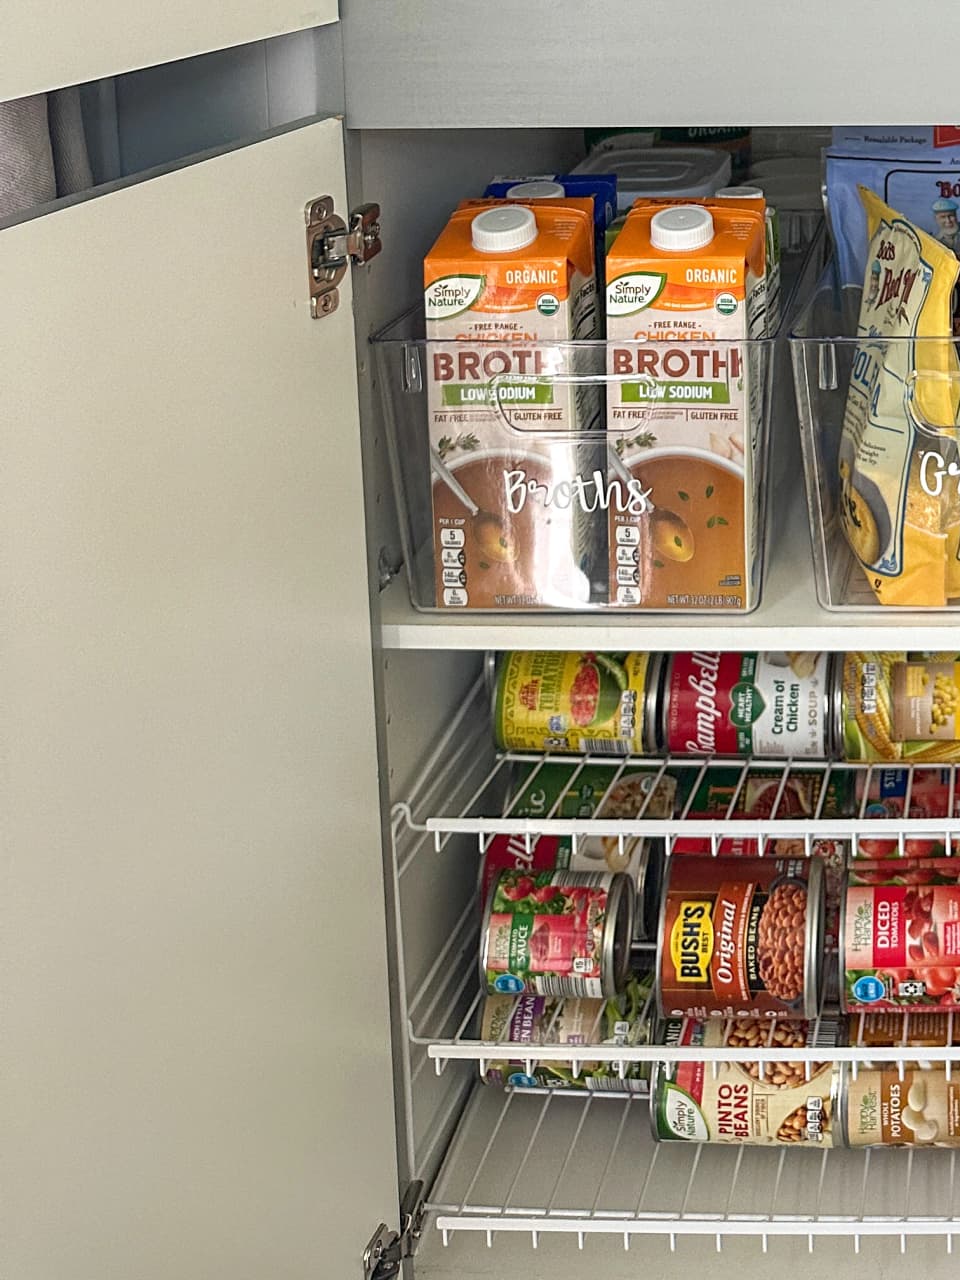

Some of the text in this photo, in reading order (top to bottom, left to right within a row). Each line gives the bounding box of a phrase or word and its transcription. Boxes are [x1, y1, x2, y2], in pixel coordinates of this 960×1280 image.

[505, 270, 559, 284] ORGANIC
[615, 283, 651, 297] Simply
[685, 269, 737, 284] ORGANIC
[428, 296, 465, 307] Nature
[434, 285, 471, 298] Simply
[609, 294, 645, 304] Nature
[474, 323, 491, 331] FREE
[653, 321, 697, 329] FREE RANGE
[460, 386, 536, 401] LOW SODIUM
[639, 384, 713, 399] LOW SODIUM
[434, 414, 447, 422] FAT
[449, 414, 468, 422] FREE
[514, 411, 563, 421] GLUTEN FREE
[612, 411, 626, 419] FAT
[628, 411, 647, 419] FREE
[690, 411, 718, 420] GLUTEN
[719, 412, 739, 420] FREE
[503, 470, 653, 515] Broths
[449, 531, 456, 540] 5
[625, 528, 631, 538] 5
[667, 596, 690, 605] NET WT
[737, 691, 747, 718] HEART
[745, 686, 753, 723] HEALTHY
[771, 679, 785, 735] Cream of
[786, 683, 800, 733] Chicken
[808, 690, 818, 726] SOUP
[852, 913, 865, 952] Happy
[861, 899, 872, 946] Harvest
[877, 901, 890, 949] DICED
[890, 901, 899, 948] TOMATOES
[516, 924, 529, 963] SAUCE
[681, 905, 706, 978] BUSH'S
[701, 931, 709, 953] BEST
[716, 900, 737, 984] Original
[747, 905, 761, 981] BAKED BEANS
[674, 1100, 688, 1132] Simply
[686, 1107, 696, 1136] Nature
[718, 1083, 733, 1135] PINTO
[733, 1083, 749, 1138] BEANS
[889, 1084, 902, 1138] POTATOES
